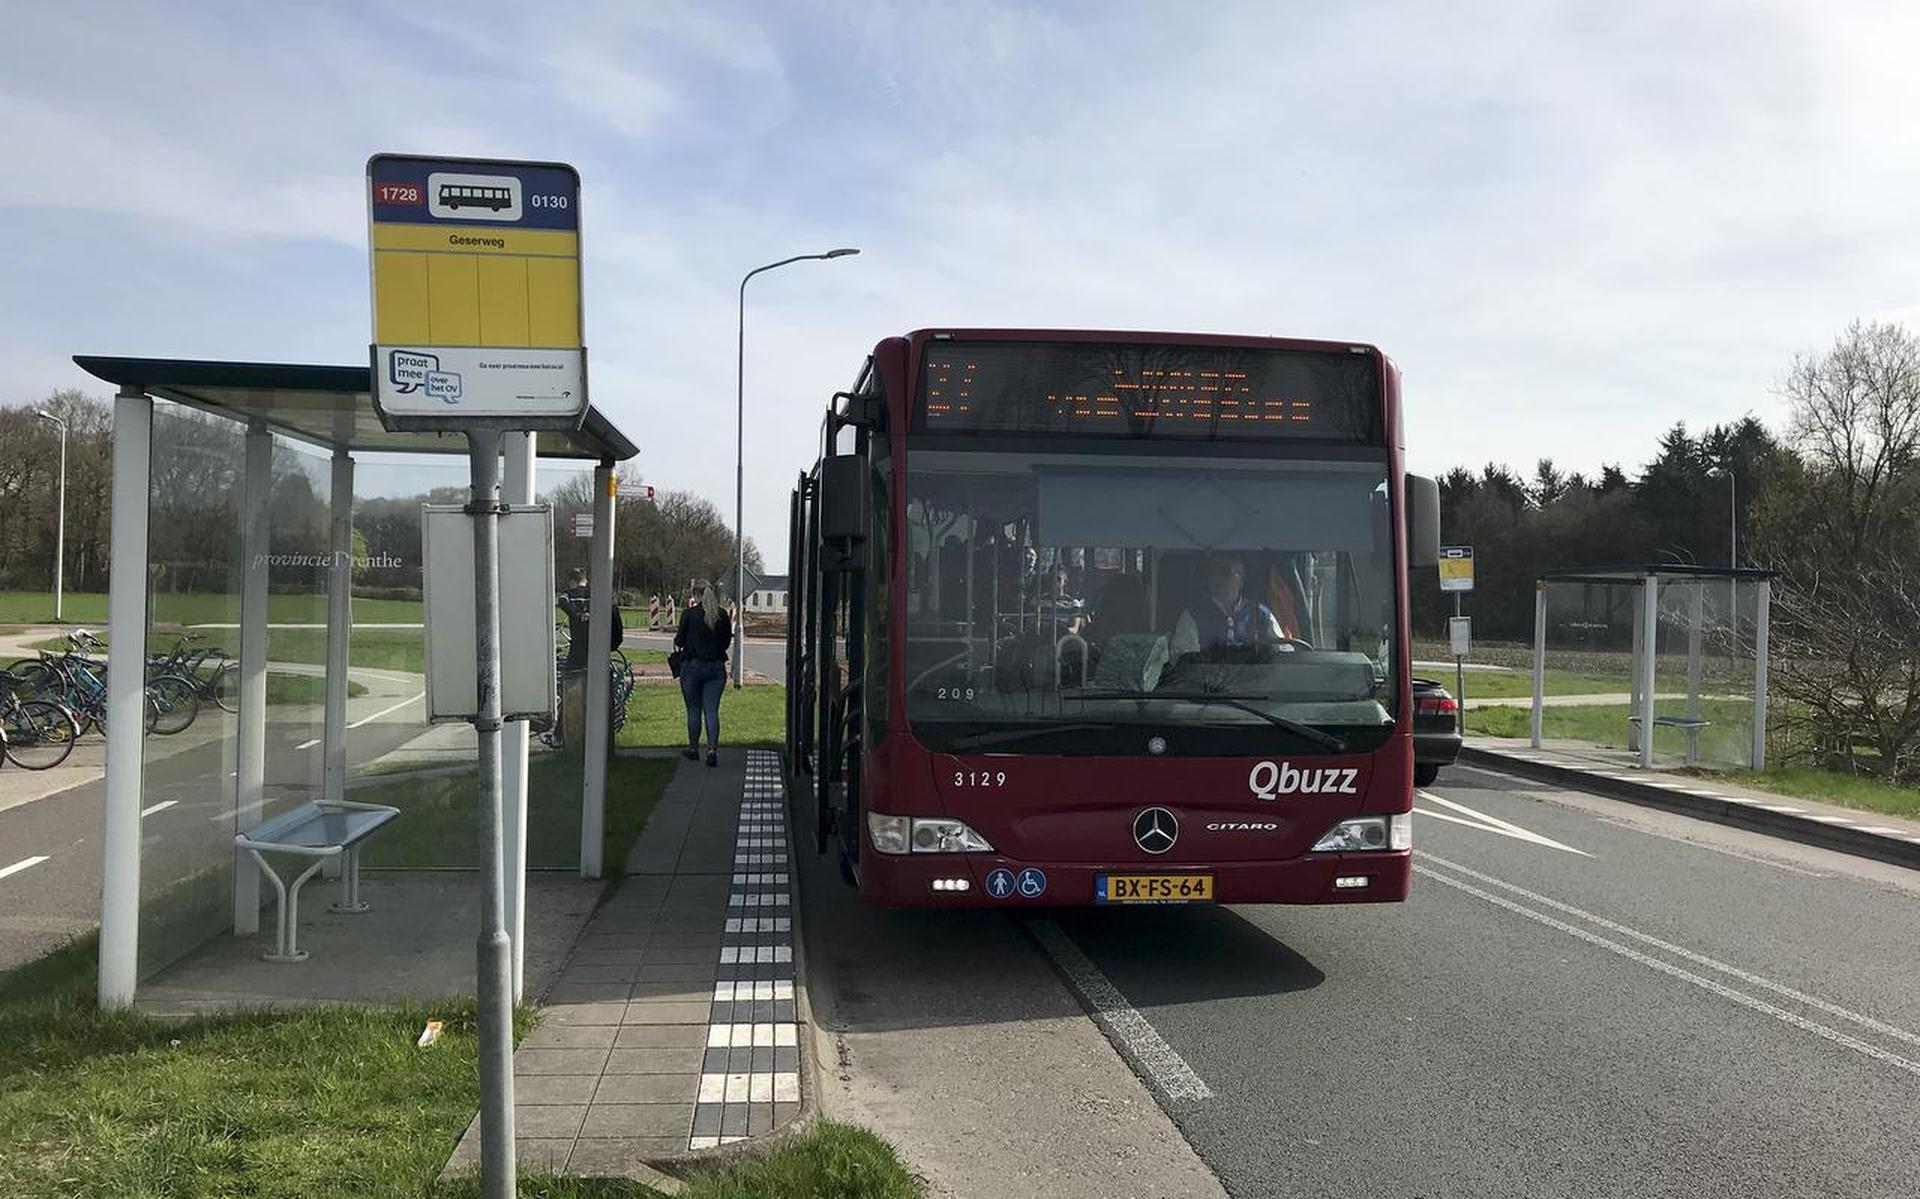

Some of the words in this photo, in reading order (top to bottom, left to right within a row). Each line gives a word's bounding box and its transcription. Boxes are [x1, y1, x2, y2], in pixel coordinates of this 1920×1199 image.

[380, 187, 418, 201] 1728
[532, 195, 568, 209] 0130
[449, 234, 505, 248] Geserweg
[397, 356, 428, 368] praat
[397, 369, 423, 379] mee
[252, 550, 331, 569] provincie
[335, 550, 402, 568] Drenthe
[938, 688, 974, 700] 209
[954, 772, 1006, 787] 3129
[1249, 761, 1358, 800] Qbuzz
[1206, 823, 1278, 831] CITARO
[1114, 879, 1205, 897] BX-FS-64
